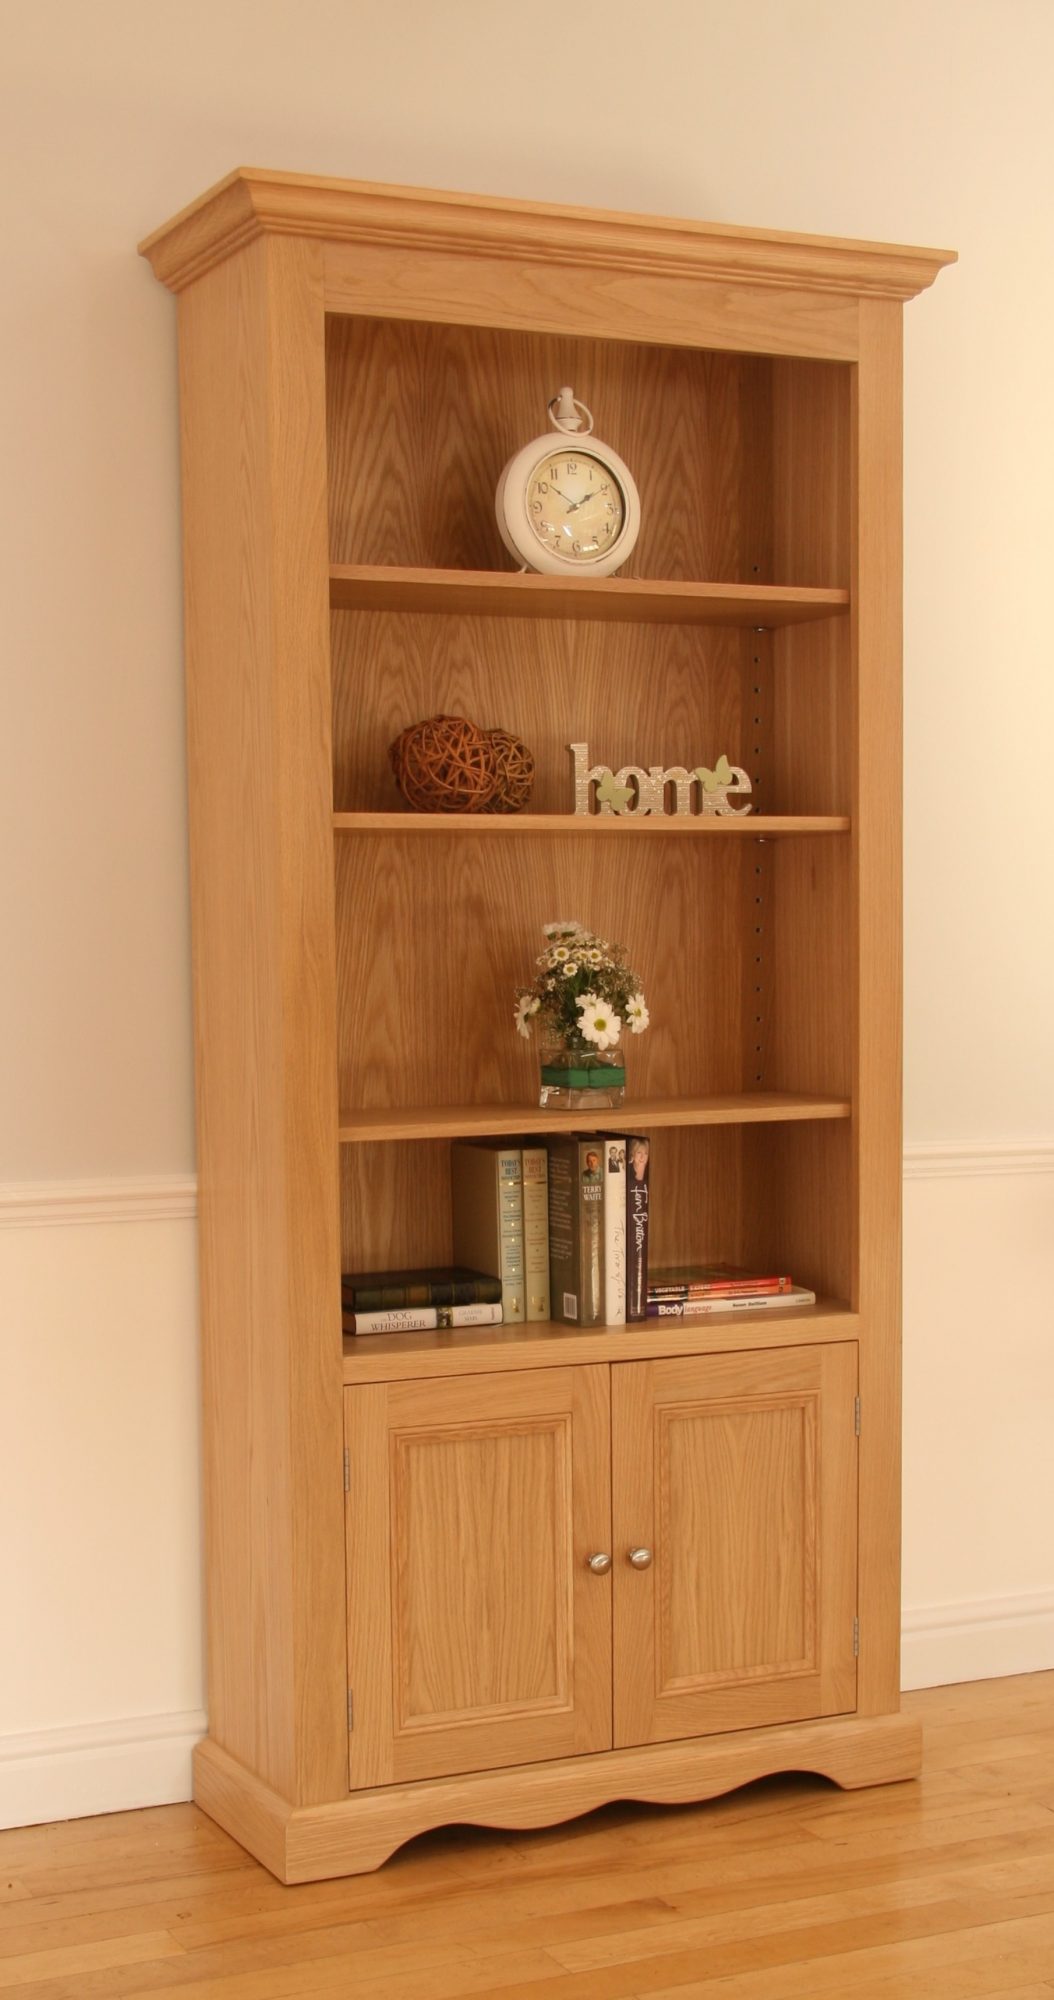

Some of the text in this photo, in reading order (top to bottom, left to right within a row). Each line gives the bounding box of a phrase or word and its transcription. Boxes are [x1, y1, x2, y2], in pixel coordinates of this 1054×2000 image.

[550, 468, 558, 480] 11
[567, 463, 577, 475] 12
[538, 482, 549, 494] 10
[533, 501, 542, 513] 9
[572, 541, 581, 553] 6
[570, 742, 752, 816] home
[583, 1186, 602, 1194] TERRY
[633, 1211, 648, 1253] Britton
[654, 1286, 685, 1294] VEGETABLE
[658, 1303, 684, 1316] Body
[684, 1305, 712, 1315] language
[387, 1311, 412, 1322] DOG
[370, 1320, 426, 1332] WHISPERER
